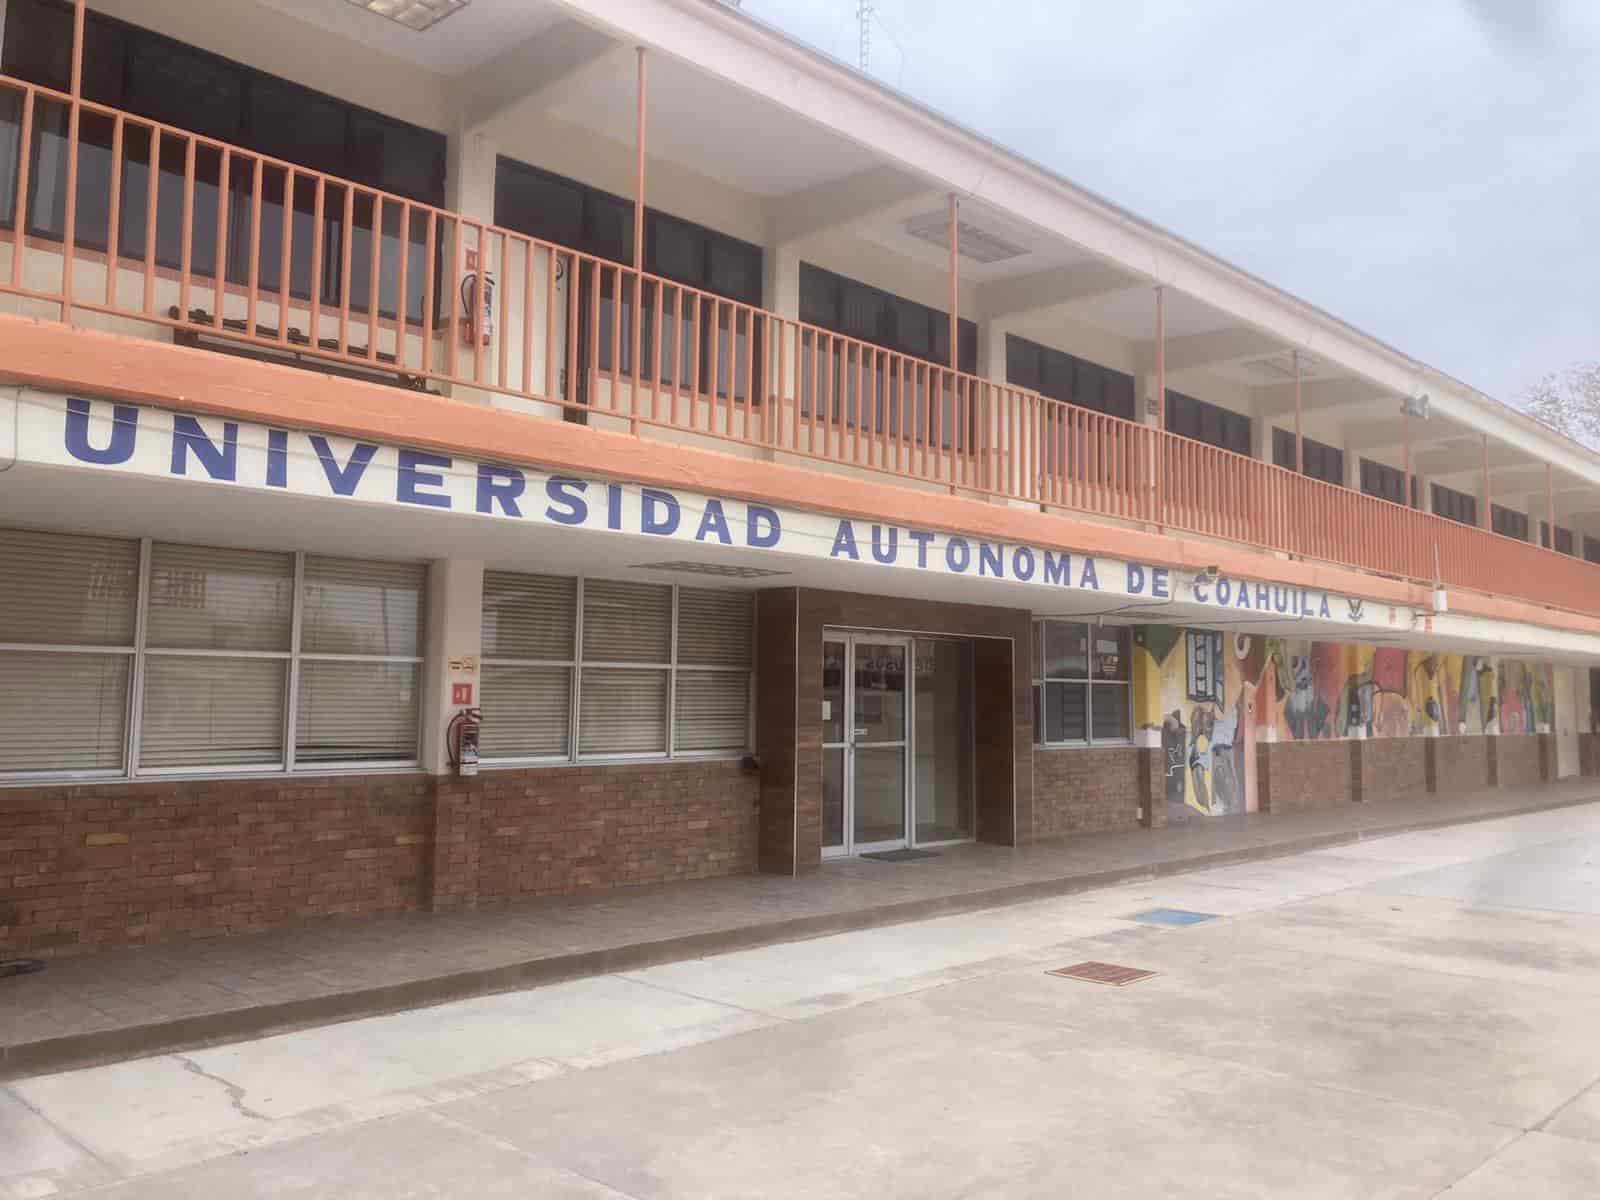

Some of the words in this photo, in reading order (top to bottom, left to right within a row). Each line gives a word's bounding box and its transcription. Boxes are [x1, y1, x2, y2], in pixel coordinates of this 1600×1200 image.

[64, 397, 782, 548] UNIVERSIDAD
[830, 519, 1100, 589] AUTONOMA
[1127, 562, 1169, 598] DE
[1193, 573, 1331, 619] COAHUILA
